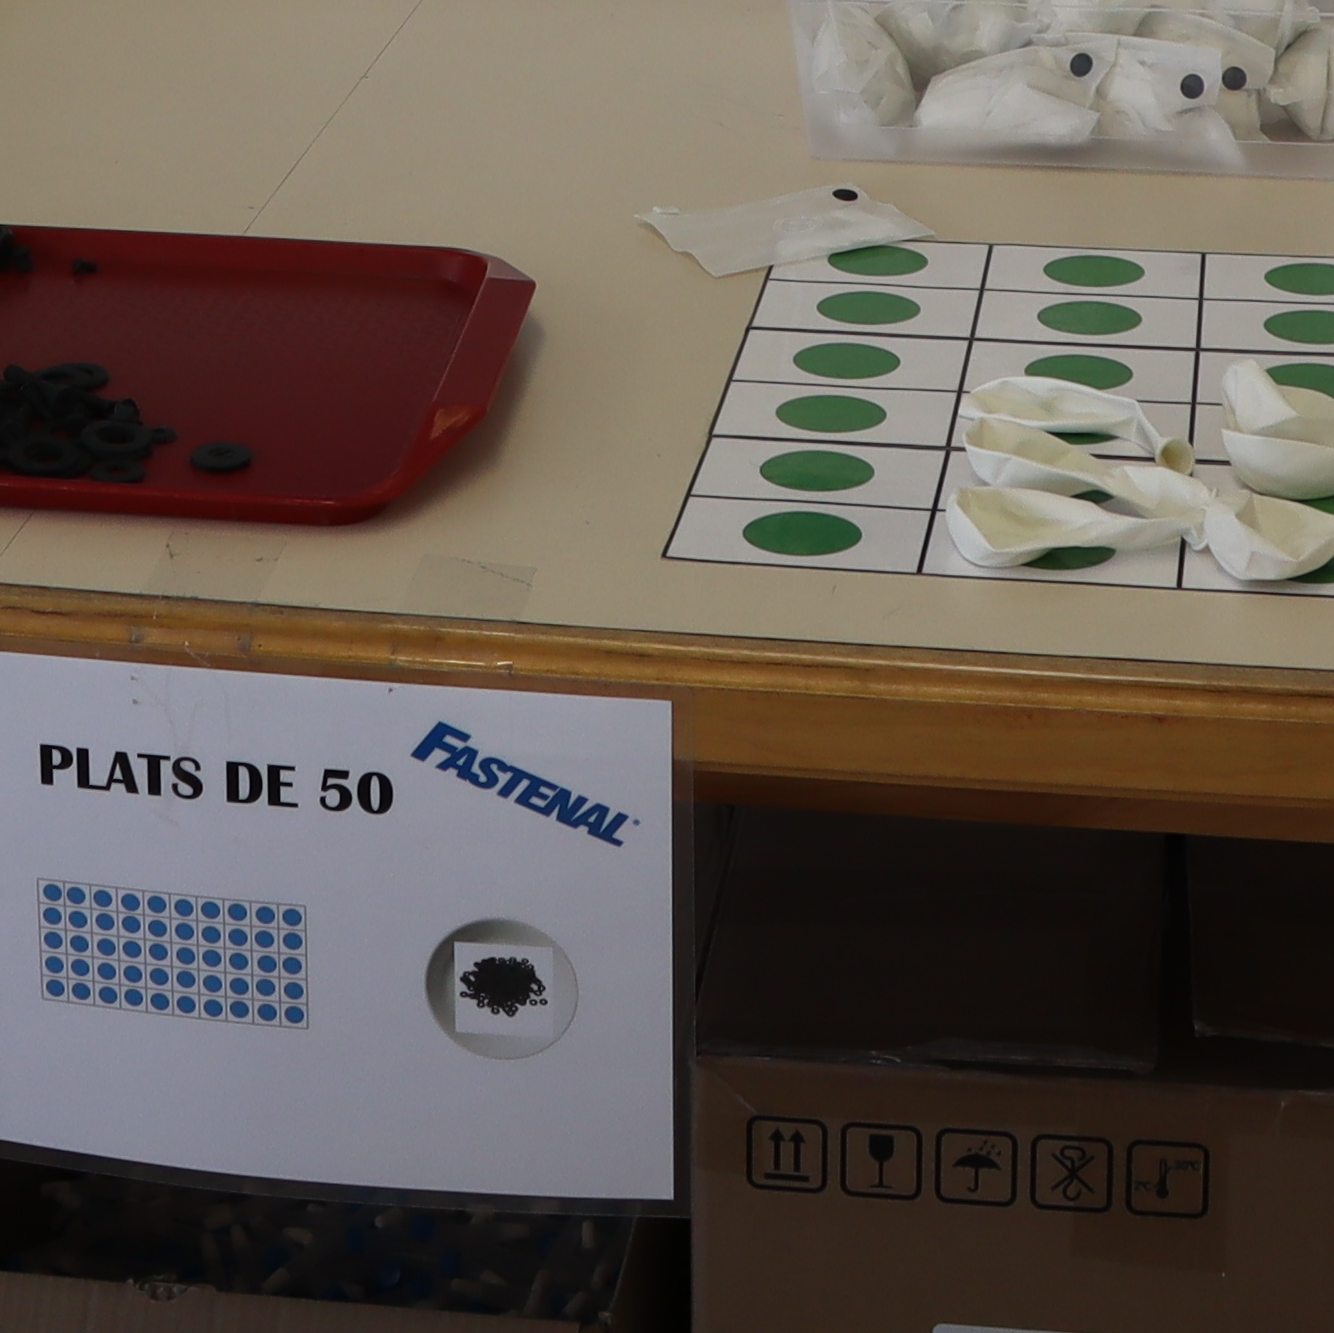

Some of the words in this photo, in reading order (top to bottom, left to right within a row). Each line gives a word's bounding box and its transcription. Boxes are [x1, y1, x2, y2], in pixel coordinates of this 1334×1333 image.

[40, 744, 204, 800] PLATS
[226, 761, 299, 808] DE
[320, 768, 394, 815] 50
[411, 721, 629, 847] FASTENAL
